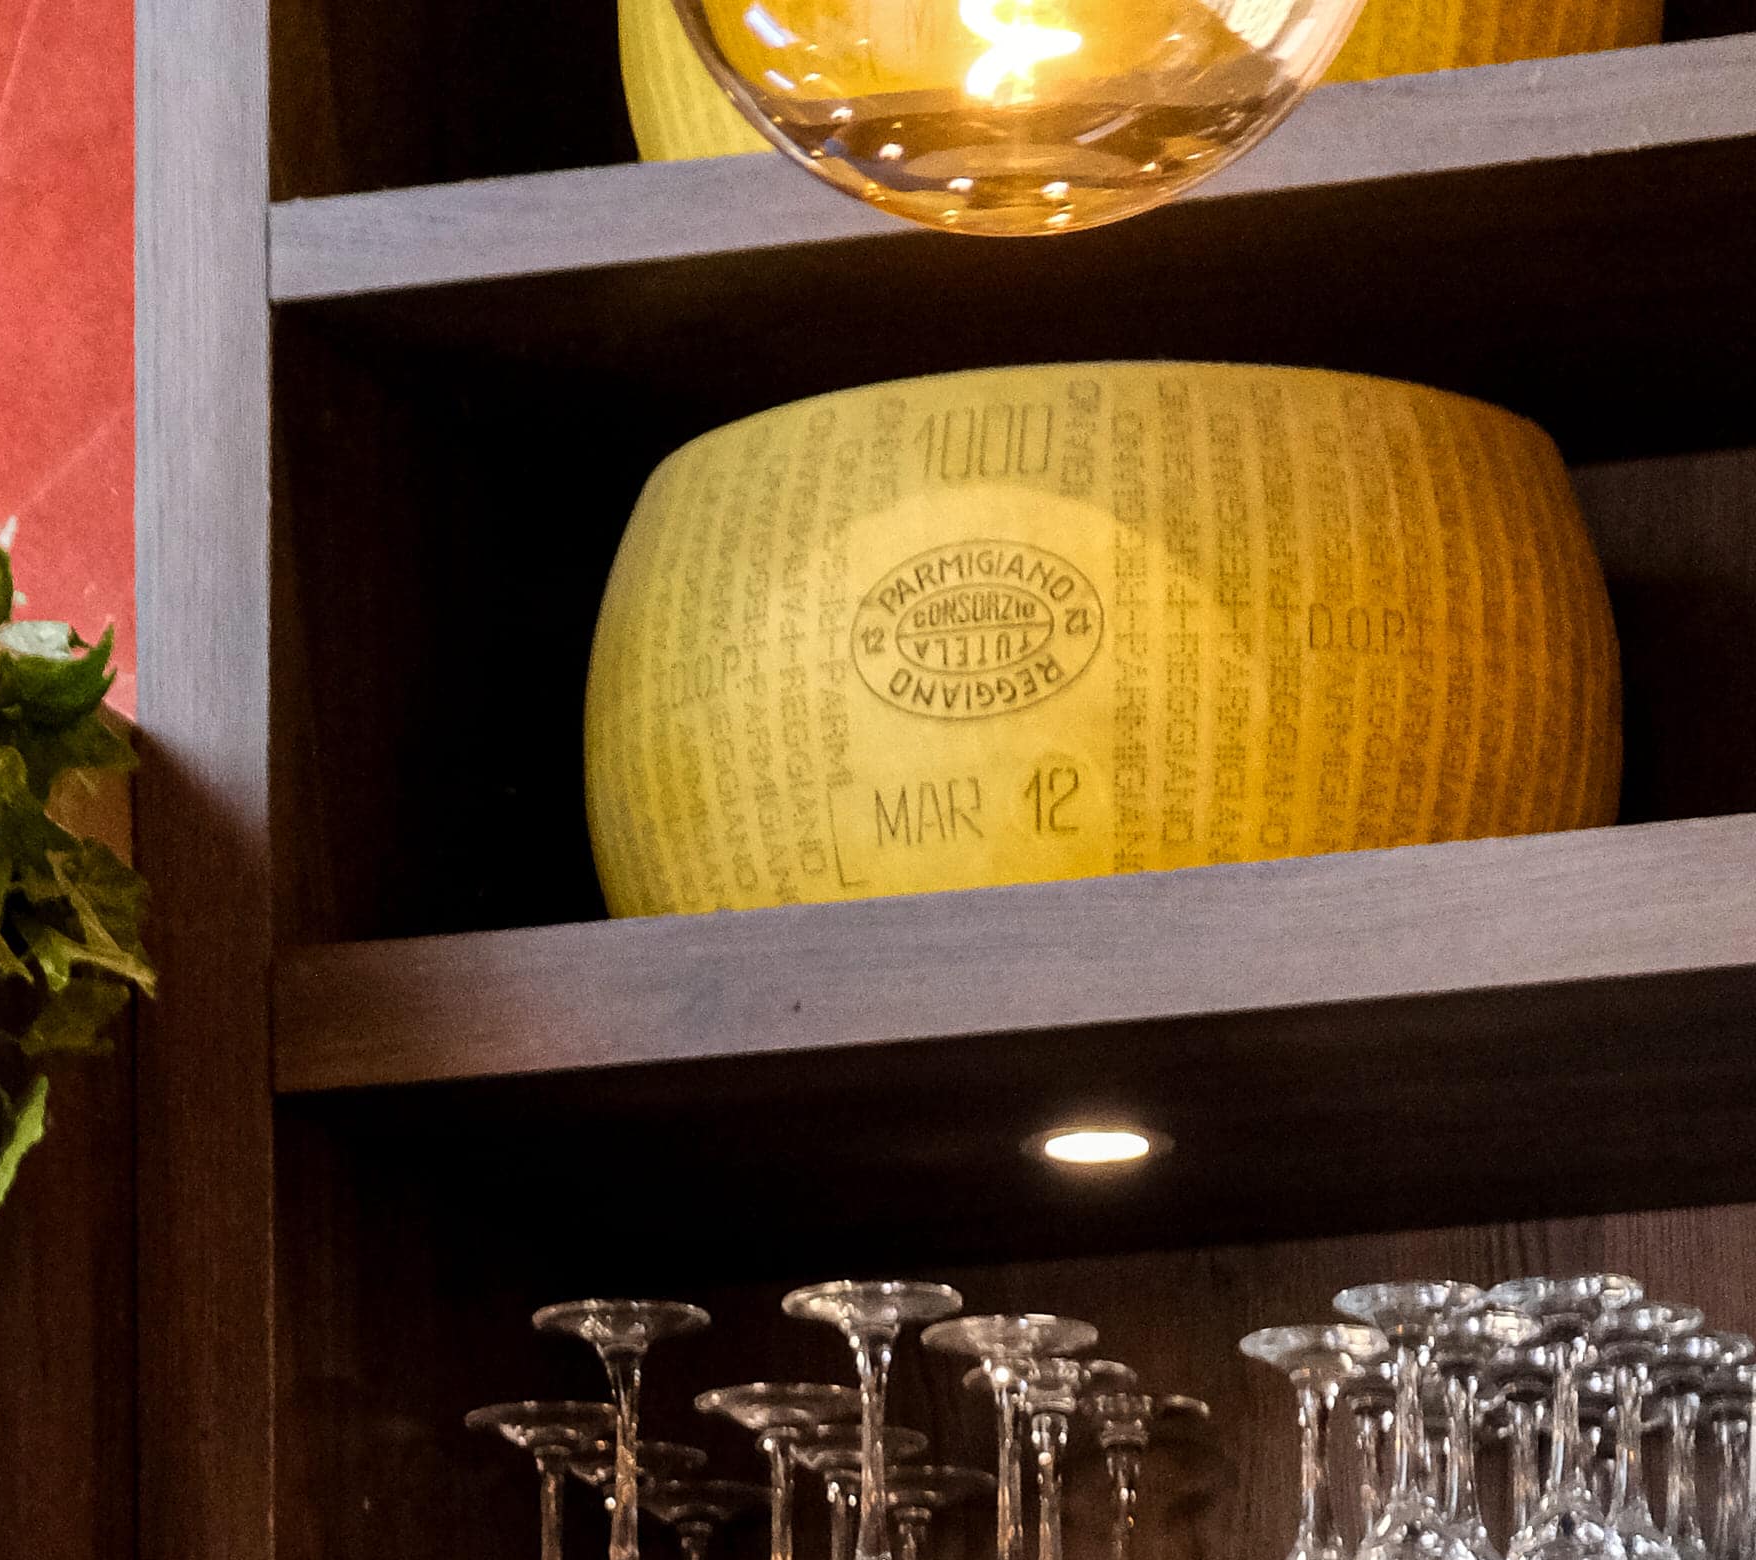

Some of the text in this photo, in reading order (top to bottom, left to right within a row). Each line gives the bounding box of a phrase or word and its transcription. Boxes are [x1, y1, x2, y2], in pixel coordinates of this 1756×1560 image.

[914, 402, 1054, 481] 1000
[878, 550, 1075, 616] PARMIGIANO
[913, 590, 1037, 628] CONSORZIO
[861, 625, 886, 655] 12
[913, 631, 1034, 667] TUTELA
[889, 654, 1066, 711] REGGIANO
[874, 766, 1080, 847] MAR 12
